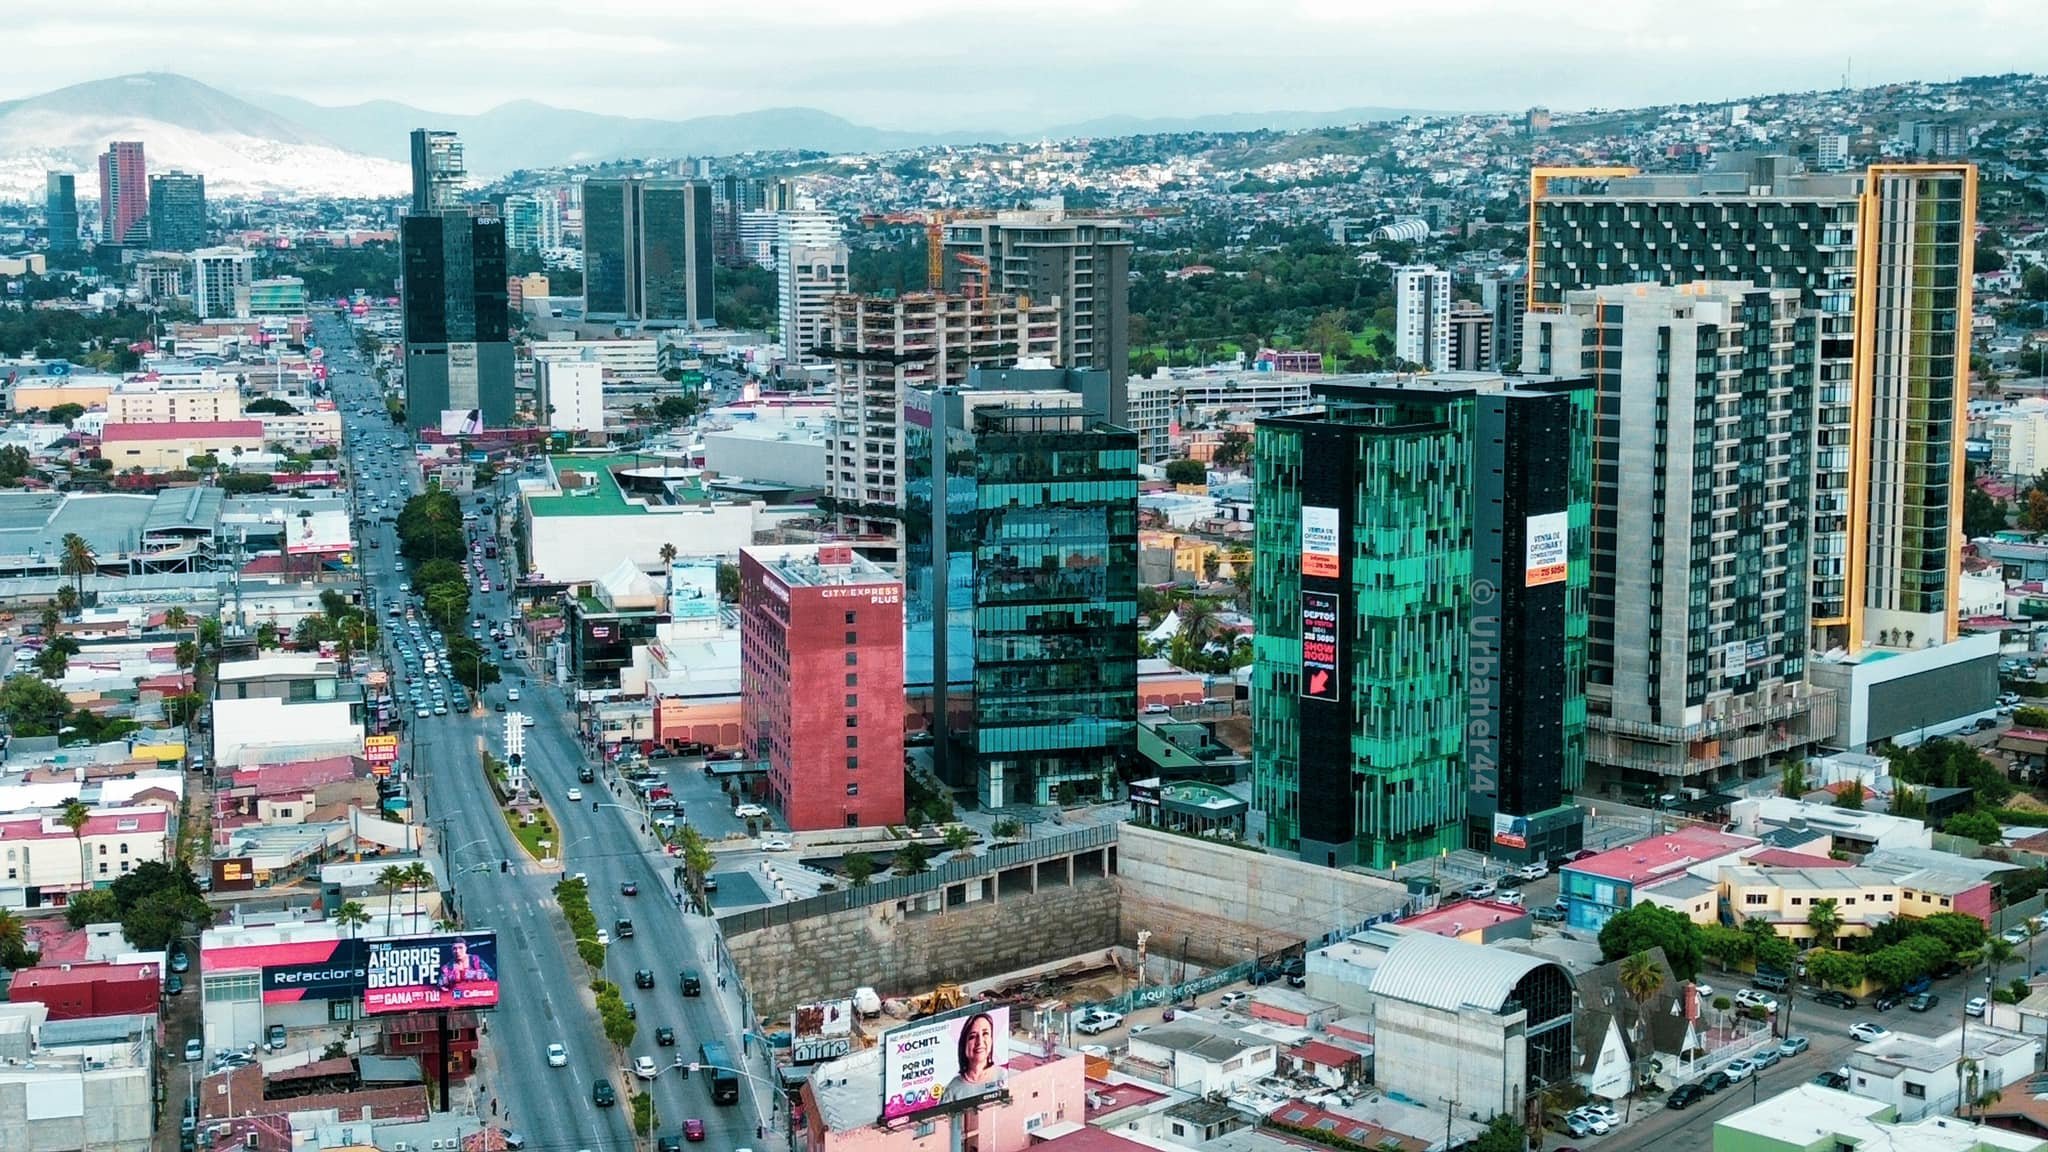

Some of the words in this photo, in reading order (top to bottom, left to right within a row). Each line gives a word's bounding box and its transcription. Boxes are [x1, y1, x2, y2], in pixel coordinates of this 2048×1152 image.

[821, 588, 847, 598] CITY
[850, 586, 898, 597] EXPRESS
[871, 595, 898, 604] PLUS
[1303, 641, 1335, 653] SHOW
[1303, 651, 1334, 663] ROOM
[368, 947, 441, 969] AHORROS
[384, 991, 413, 1005] GANA
[903, 1061, 920, 1072] POR
[921, 1057, 934, 1067] UN
